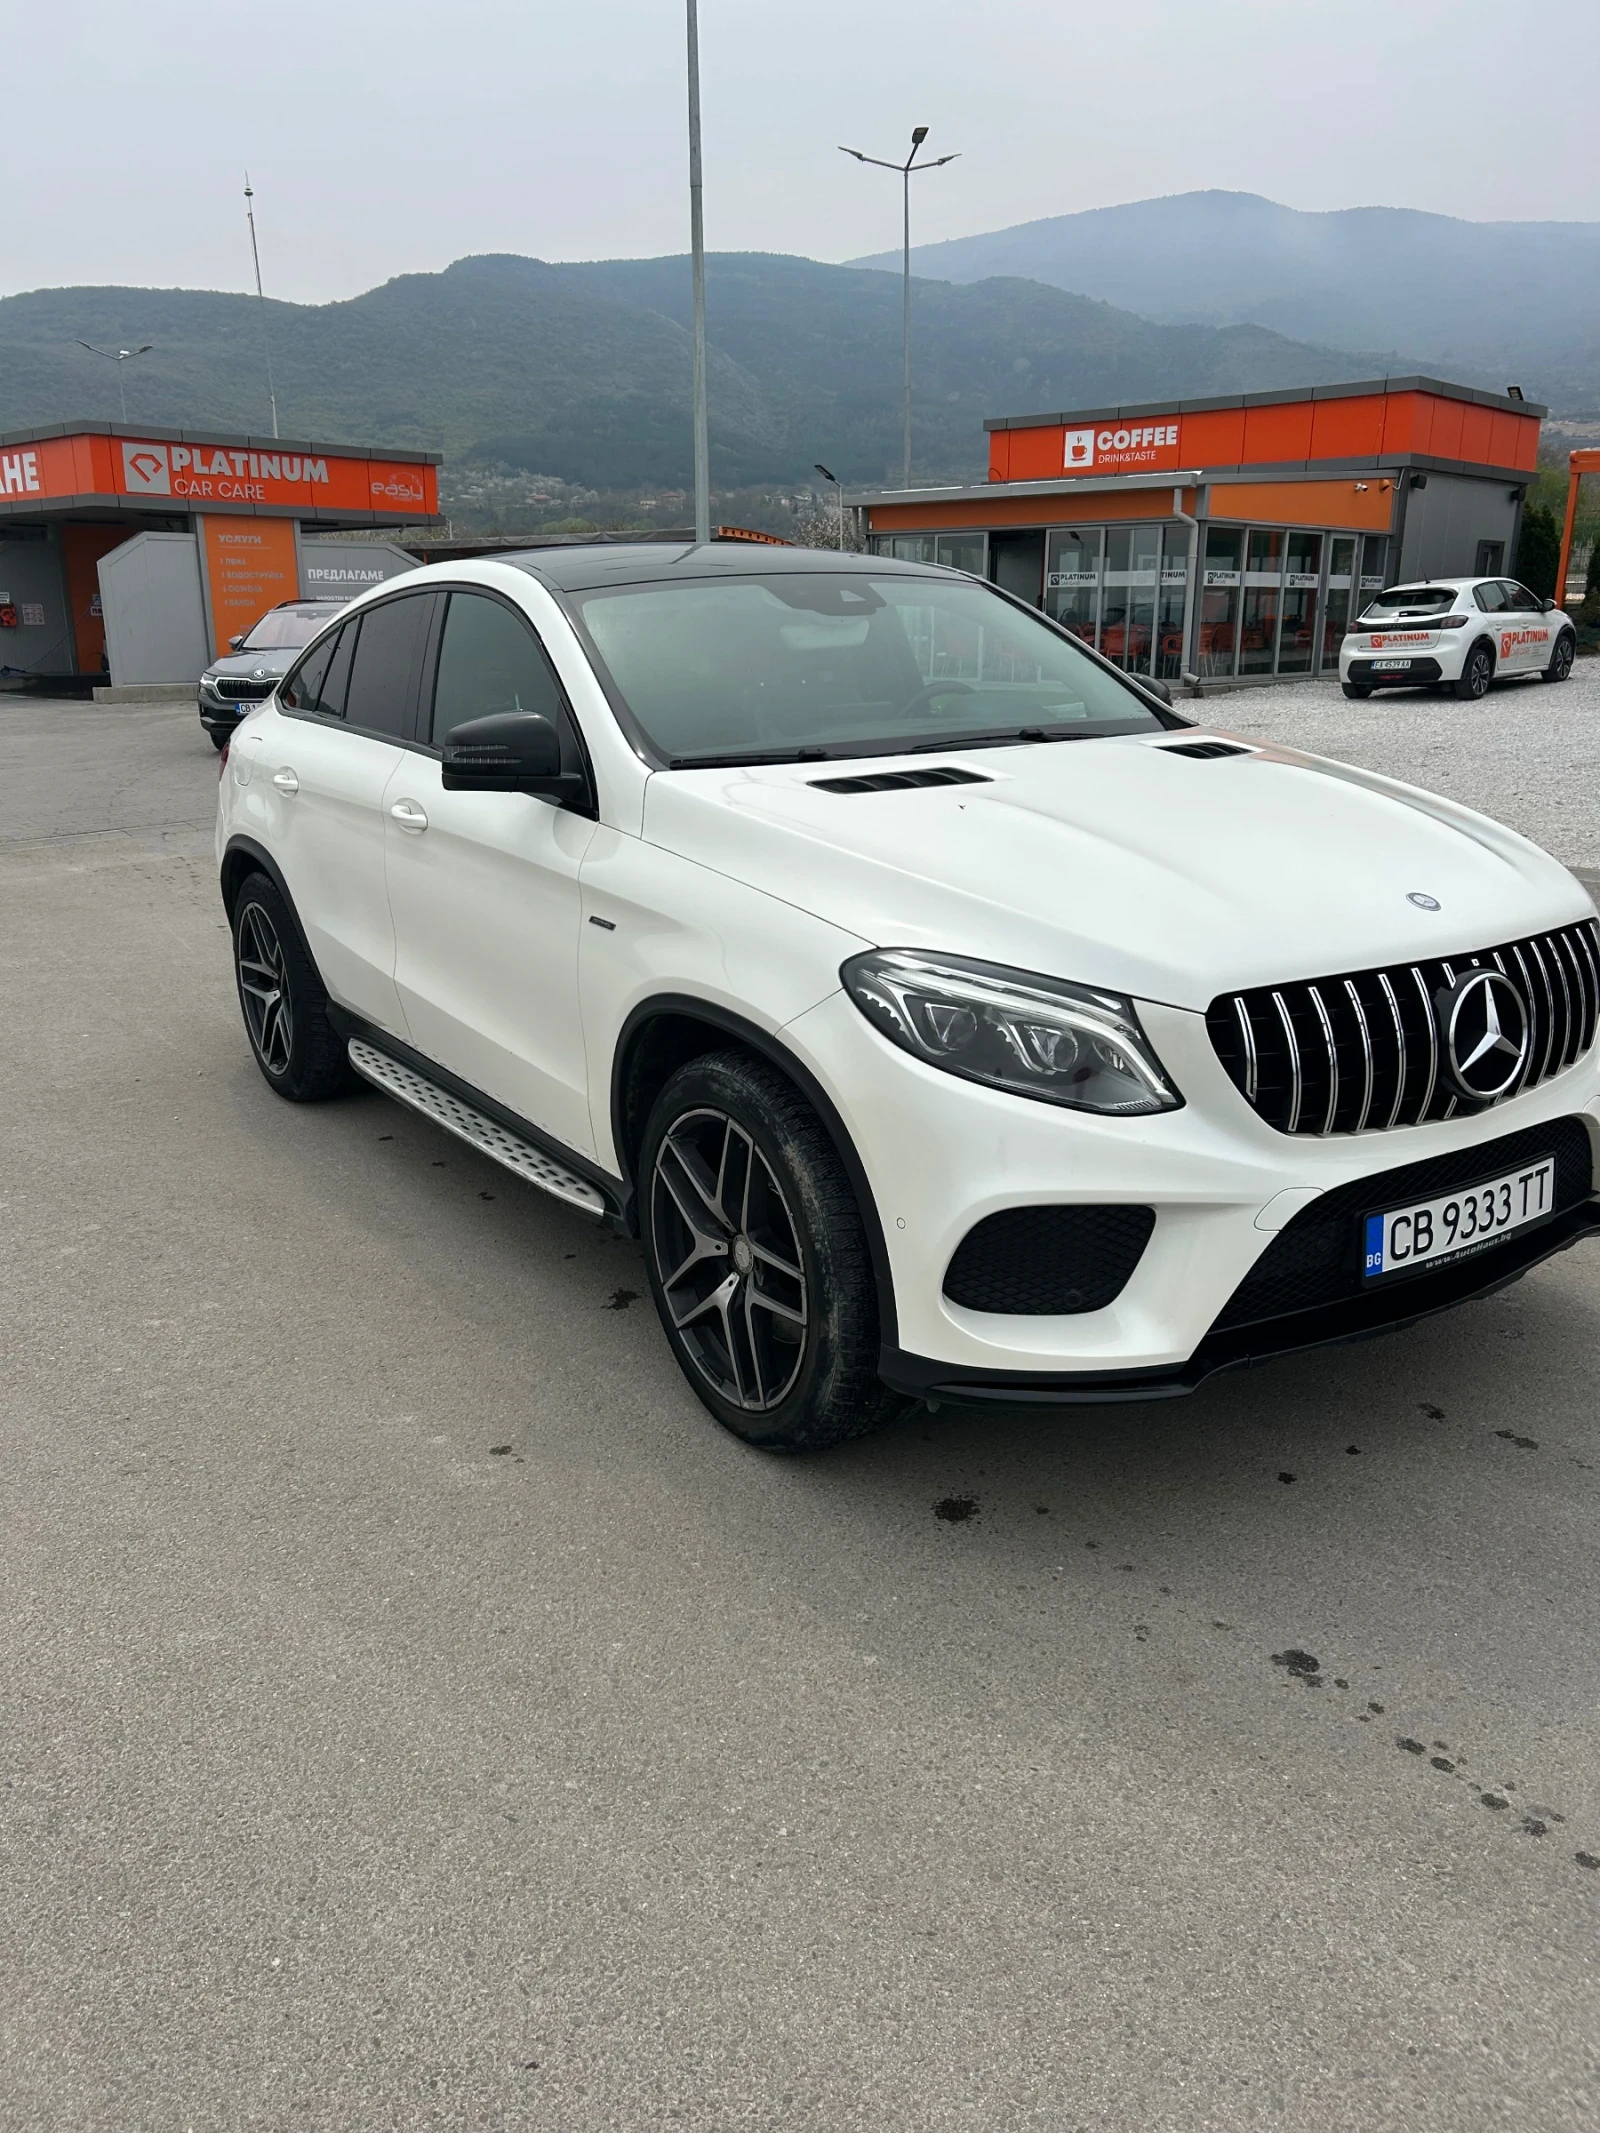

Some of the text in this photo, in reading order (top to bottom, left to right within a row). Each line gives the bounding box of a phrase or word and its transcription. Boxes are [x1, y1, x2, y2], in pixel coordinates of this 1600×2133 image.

[1097, 425, 1178, 450] COFFEE
[171, 446, 329, 483] PLATINUM
[1098, 450, 1156, 464] DRINK&TASTE
[0, 452, 40, 494] НЕ
[174, 478, 265, 500] CAR CARE
[371, 482, 423, 500] easy
[218, 534, 262, 544] УСЛУГИ
[307, 568, 384, 581] ПРЕДЛАГАМЕ
[1382, 633, 1430, 642] PLATINUM
[1511, 628, 1549, 645] PLATINUM
[1390, 1165, 1550, 1261] CB 9333 TT
[1366, 1252, 1382, 1268] BG
